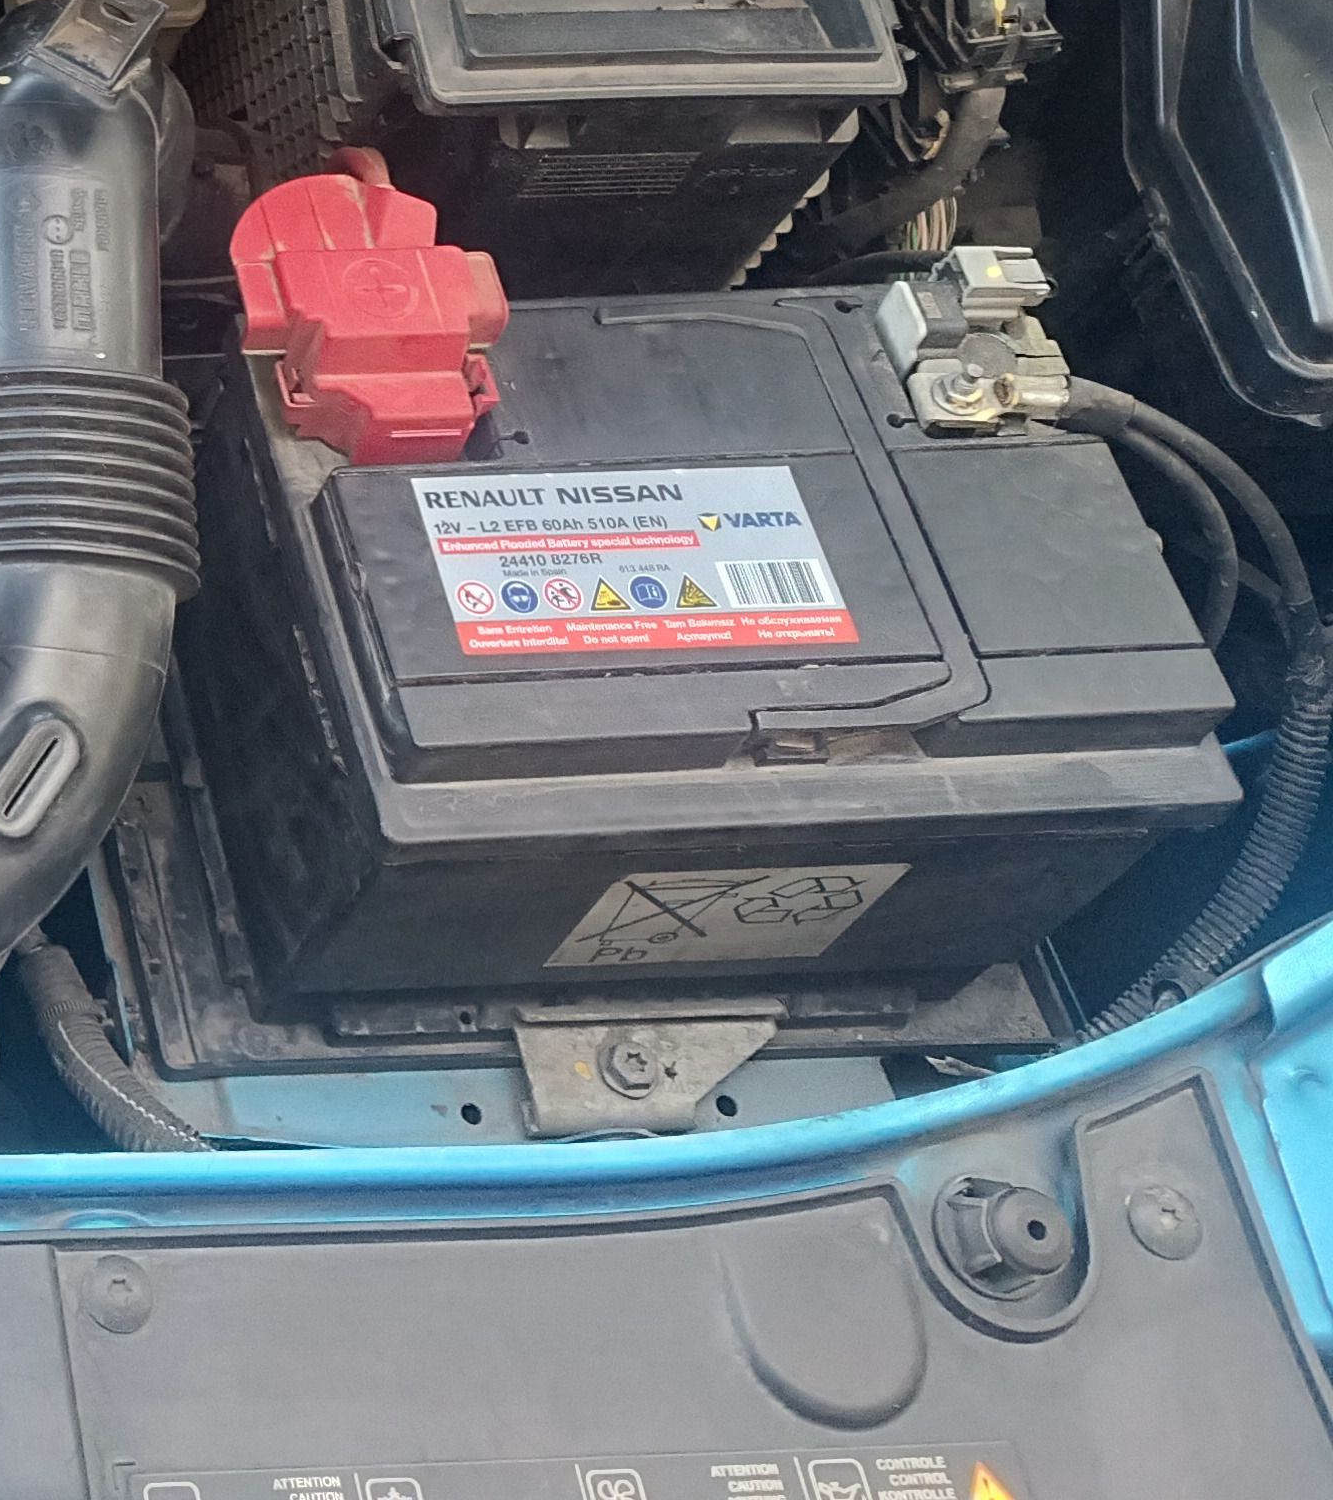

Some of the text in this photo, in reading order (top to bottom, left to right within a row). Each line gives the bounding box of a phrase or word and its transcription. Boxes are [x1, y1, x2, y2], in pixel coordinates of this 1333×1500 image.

[423, 484, 683, 508] RENAULT NISSAN
[434, 520, 461, 534] 12V
[480, 521, 501, 533] L2
[505, 520, 538, 532] EFB
[542, 518, 583, 531] 60Ah
[588, 517, 629, 530] 510A
[633, 515, 668, 530] (EN)
[723, 511, 802, 528] VARTA
[442, 533, 695, 551] Enhanced Flooded Battery special technology
[499, 553, 602, 568] 24410 8276R
[566, 621, 658, 633] Maintenance Free
[583, 635, 599, 645] Do
[600, 635, 618, 644] not
[589, 946, 649, 964] Pb
[710, 1463, 780, 1478] ATTENTION
[876, 1456, 947, 1471] CONTROLE
[273, 1476, 341, 1490] ATTENTION
[727, 1479, 784, 1492] CAUTION
[889, 1472, 952, 1486] CONTROL
[878, 1487, 957, 1500] KONTROLLE
